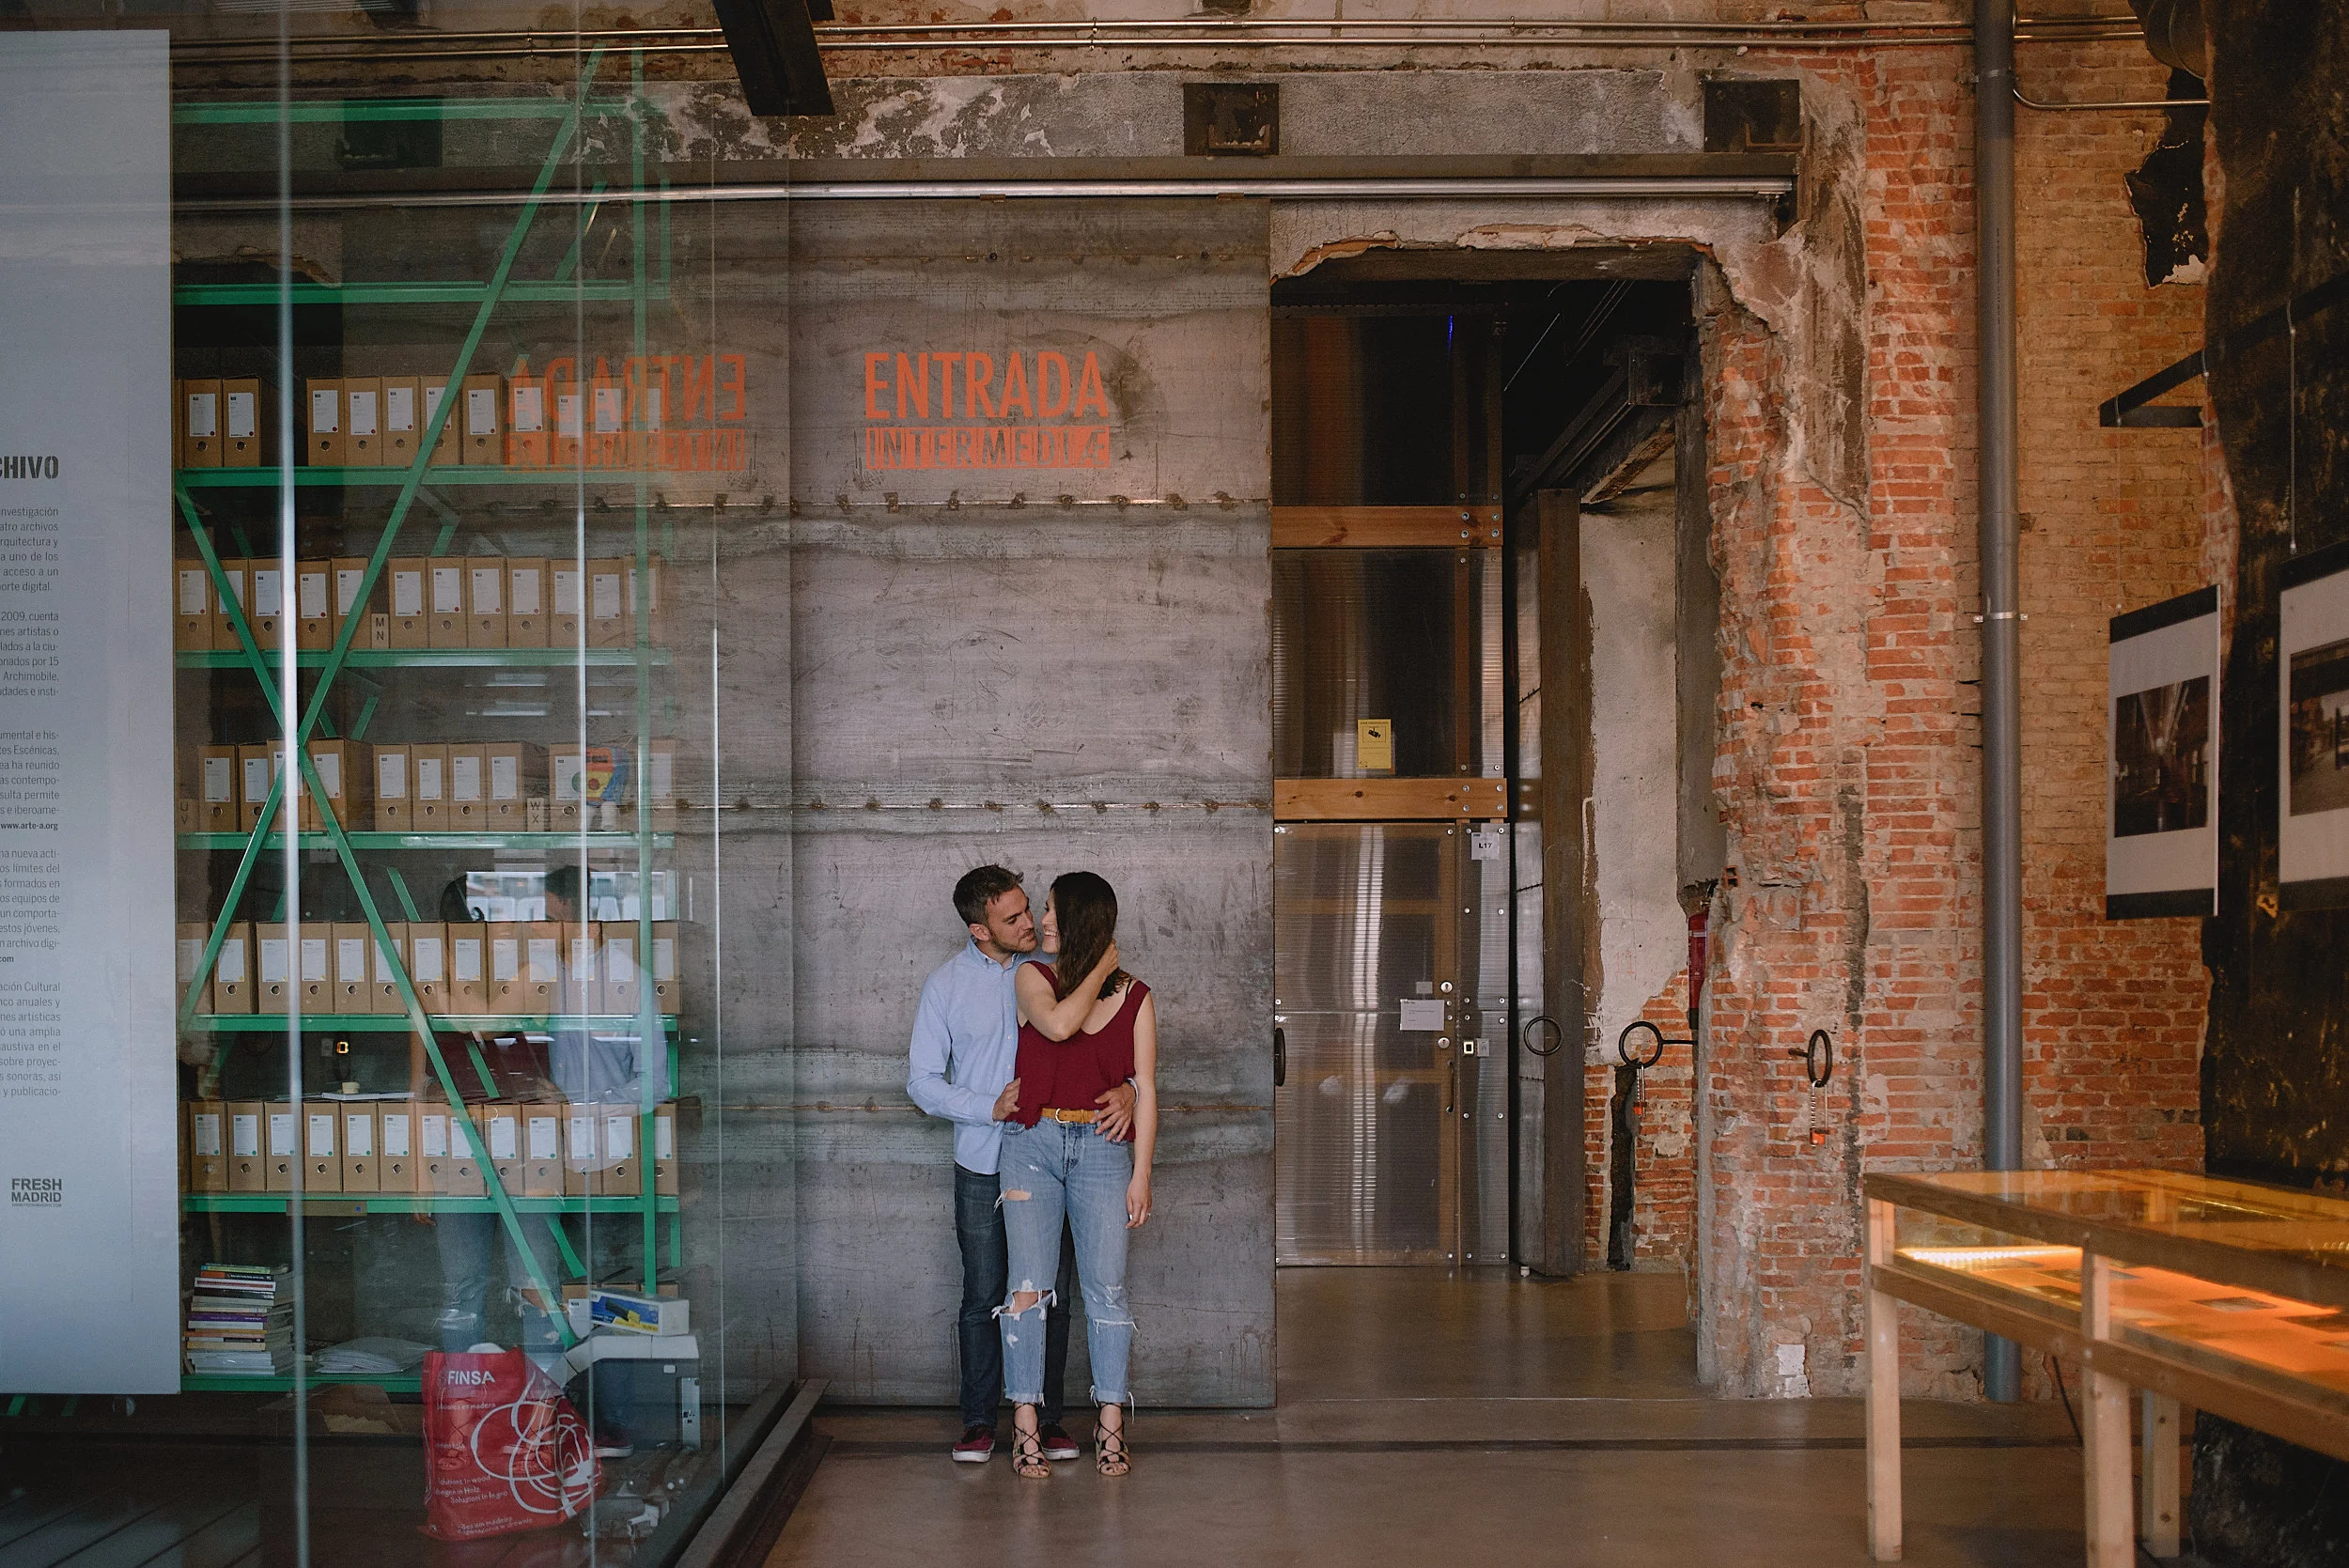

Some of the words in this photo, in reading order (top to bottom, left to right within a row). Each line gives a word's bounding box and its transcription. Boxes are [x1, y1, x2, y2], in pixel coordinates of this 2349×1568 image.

[864, 350, 1109, 419] ENTRADA
[20, 521, 58, 532] archivos
[53, 539, 58, 548] y
[30, 551, 42, 561] de
[45, 551, 59, 561] los
[23, 582, 53, 593] digital.
[29, 613, 59, 621] cuenta
[376, 617, 384, 627] M
[17, 627, 51, 636] artistas
[377, 630, 383, 641] N
[33, 642, 40, 651] la
[32, 659, 47, 668] por
[49, 657, 59, 666] 15
[3, 672, 59, 682] Archimobile,
[14, 745, 60, 755] Escénicas,
[11, 760, 23, 769] ha
[25, 760, 60, 769] reunido
[24, 791, 60, 801] permite
[13, 864, 44, 873] límites
[46, 863, 60, 873] del
[4, 879, 47, 888] formados
[11, 895, 47, 906] equipos
[49, 893, 60, 903] de
[7, 939, 39, 948] archivo
[24, 982, 61, 992] Cultural
[16, 998, 53, 1006] anuales
[55, 1000, 61, 1008] y
[18, 1013, 61, 1021] artísticas
[29, 1028, 61, 1038] amplia
[53, 1043, 61, 1051] el
[26, 1060, 61, 1068] proyec-
[48, 1072, 62, 1081] así
[11, 1178, 62, 1190] FRESH
[11, 1192, 61, 1202] MADRID
[448, 1371, 495, 1385] FINSA
